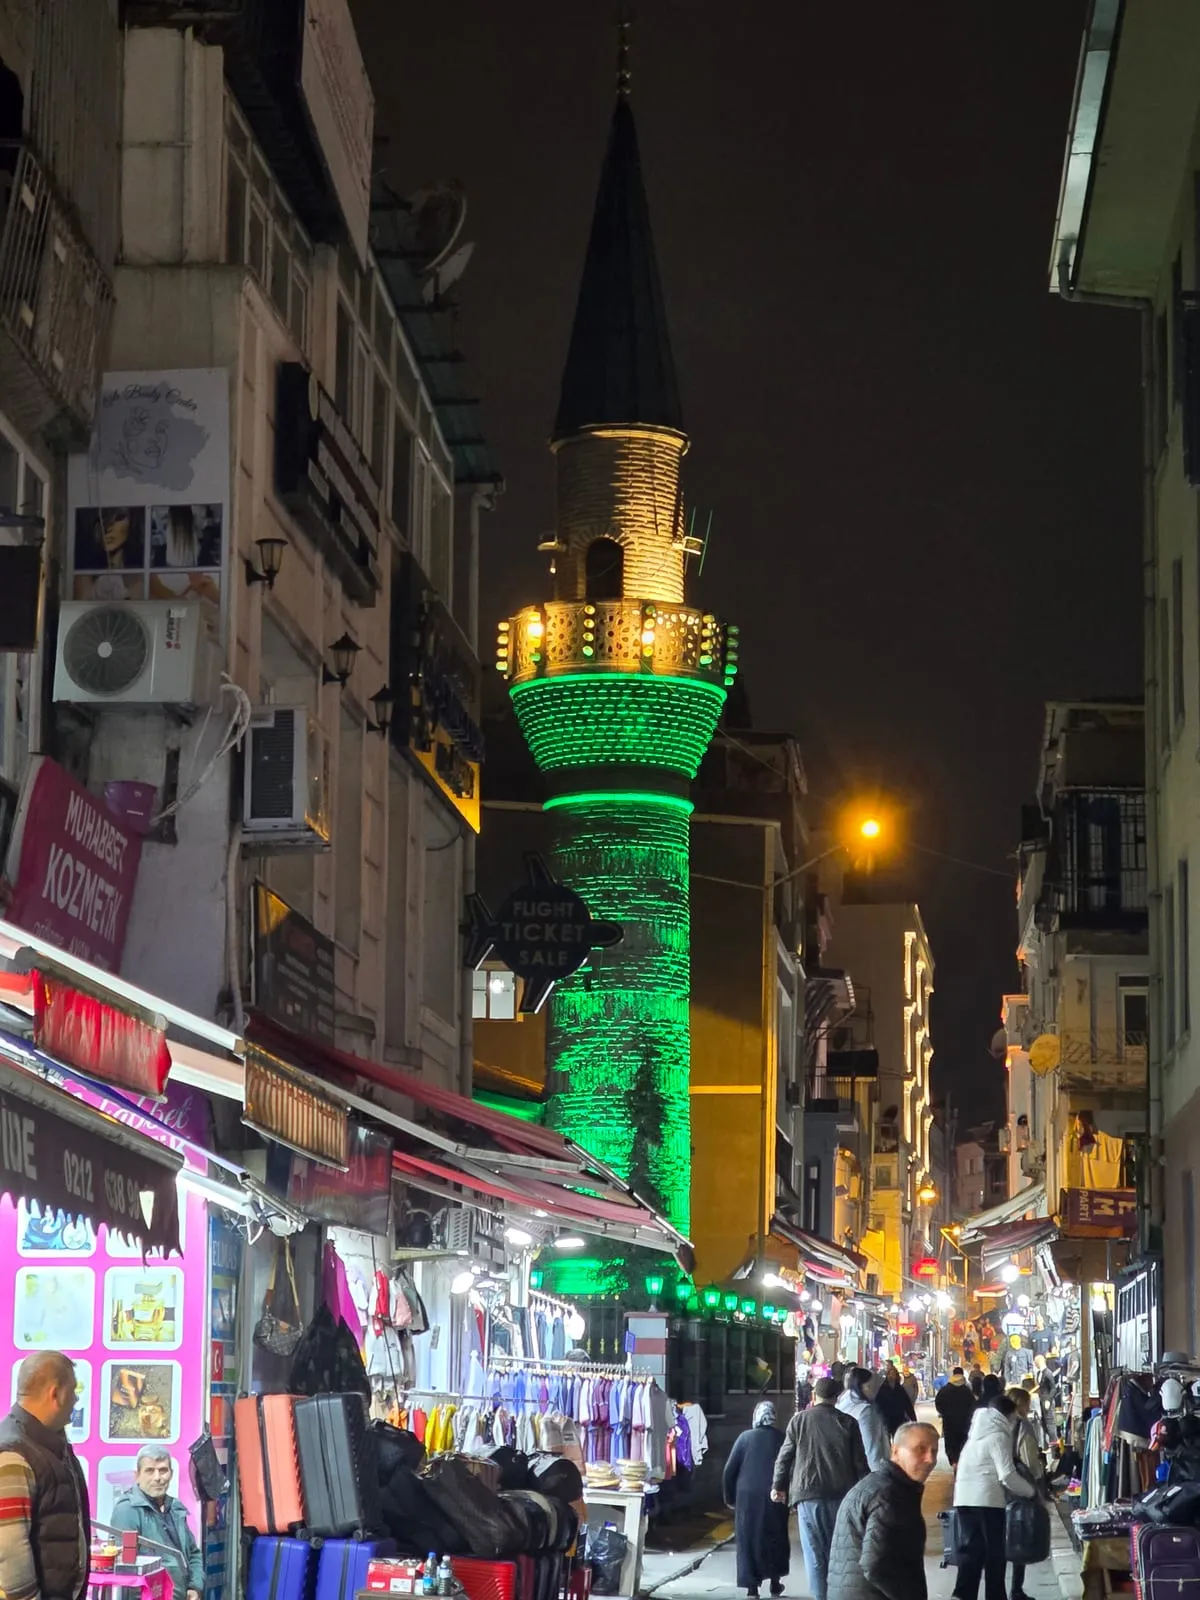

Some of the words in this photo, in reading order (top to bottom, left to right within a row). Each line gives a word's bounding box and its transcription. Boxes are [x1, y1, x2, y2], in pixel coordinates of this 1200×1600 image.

[64, 790, 128, 873] MUHABBET
[513, 902, 574, 917] FLIGHT
[502, 923, 585, 943] TICKET
[519, 951, 568, 965] SALE
[63, 1149, 95, 1203] 0212
[1080, 1190, 1092, 1222] PARTİ
